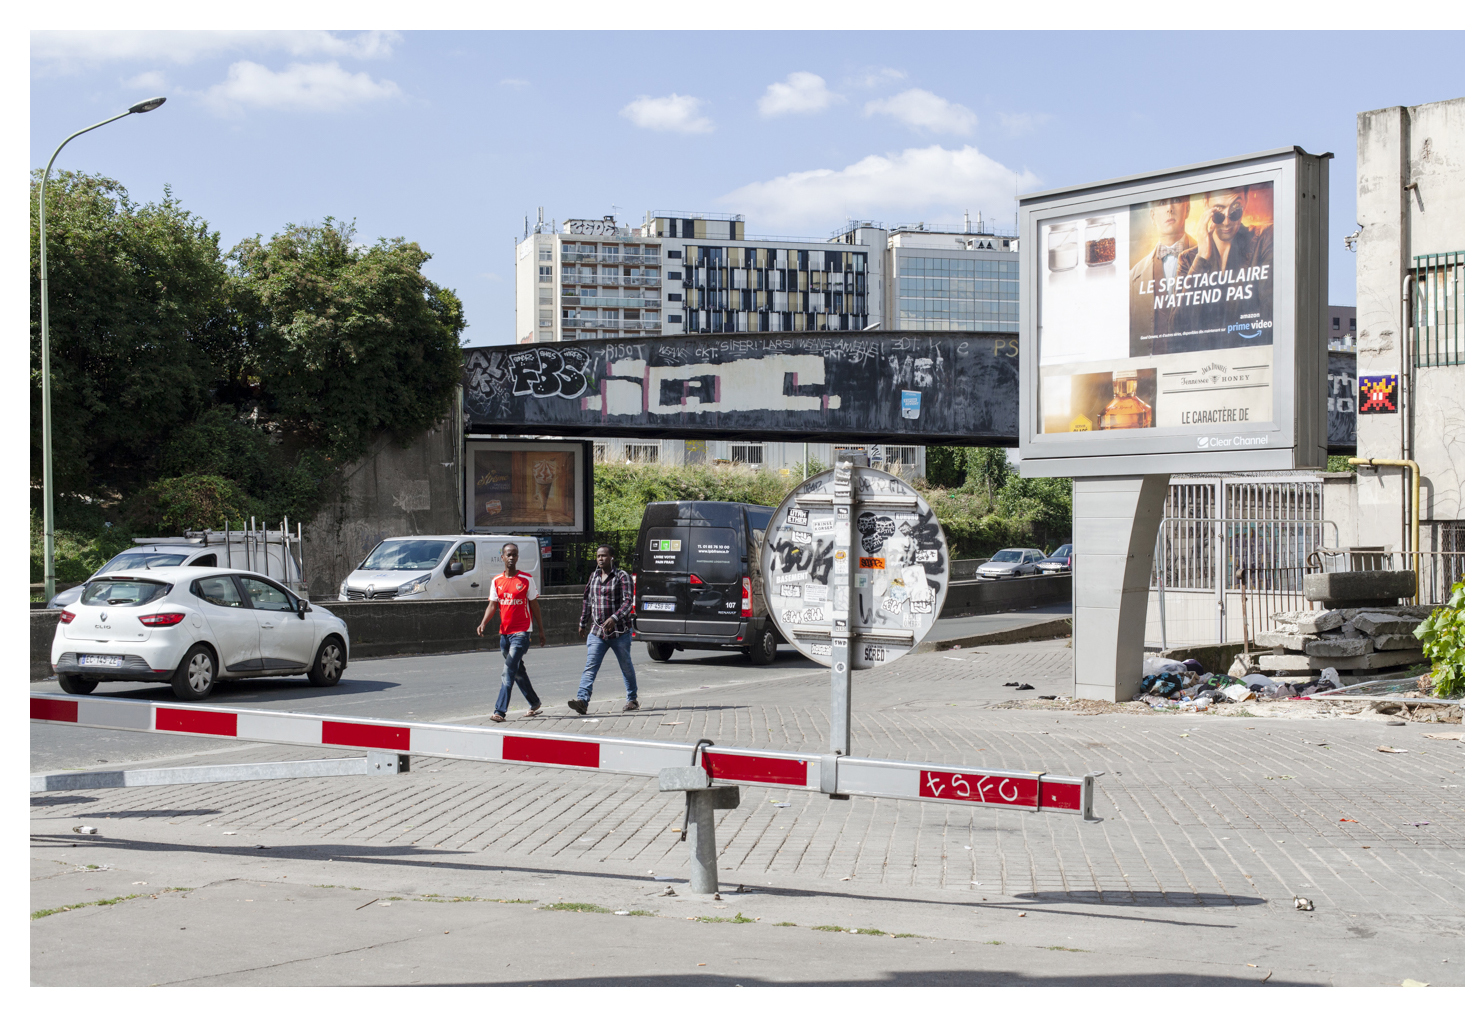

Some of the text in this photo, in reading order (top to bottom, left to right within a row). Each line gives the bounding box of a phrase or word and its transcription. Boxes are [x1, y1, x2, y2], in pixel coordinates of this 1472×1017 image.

[1139, 264, 1270, 294] LE SPECTACULAIRE
[1154, 284, 1253, 309] N'ATTEND PAS
[1227, 320, 1273, 333] prime video
[1221, 374, 1250, 382] HONEY
[1181, 406, 1249, 424] LE CARACTÈRE DE
[1209, 434, 1268, 448] Clear Channel
[776, 572, 809, 584] BASEMENT
[864, 648, 885, 661] SCRED
